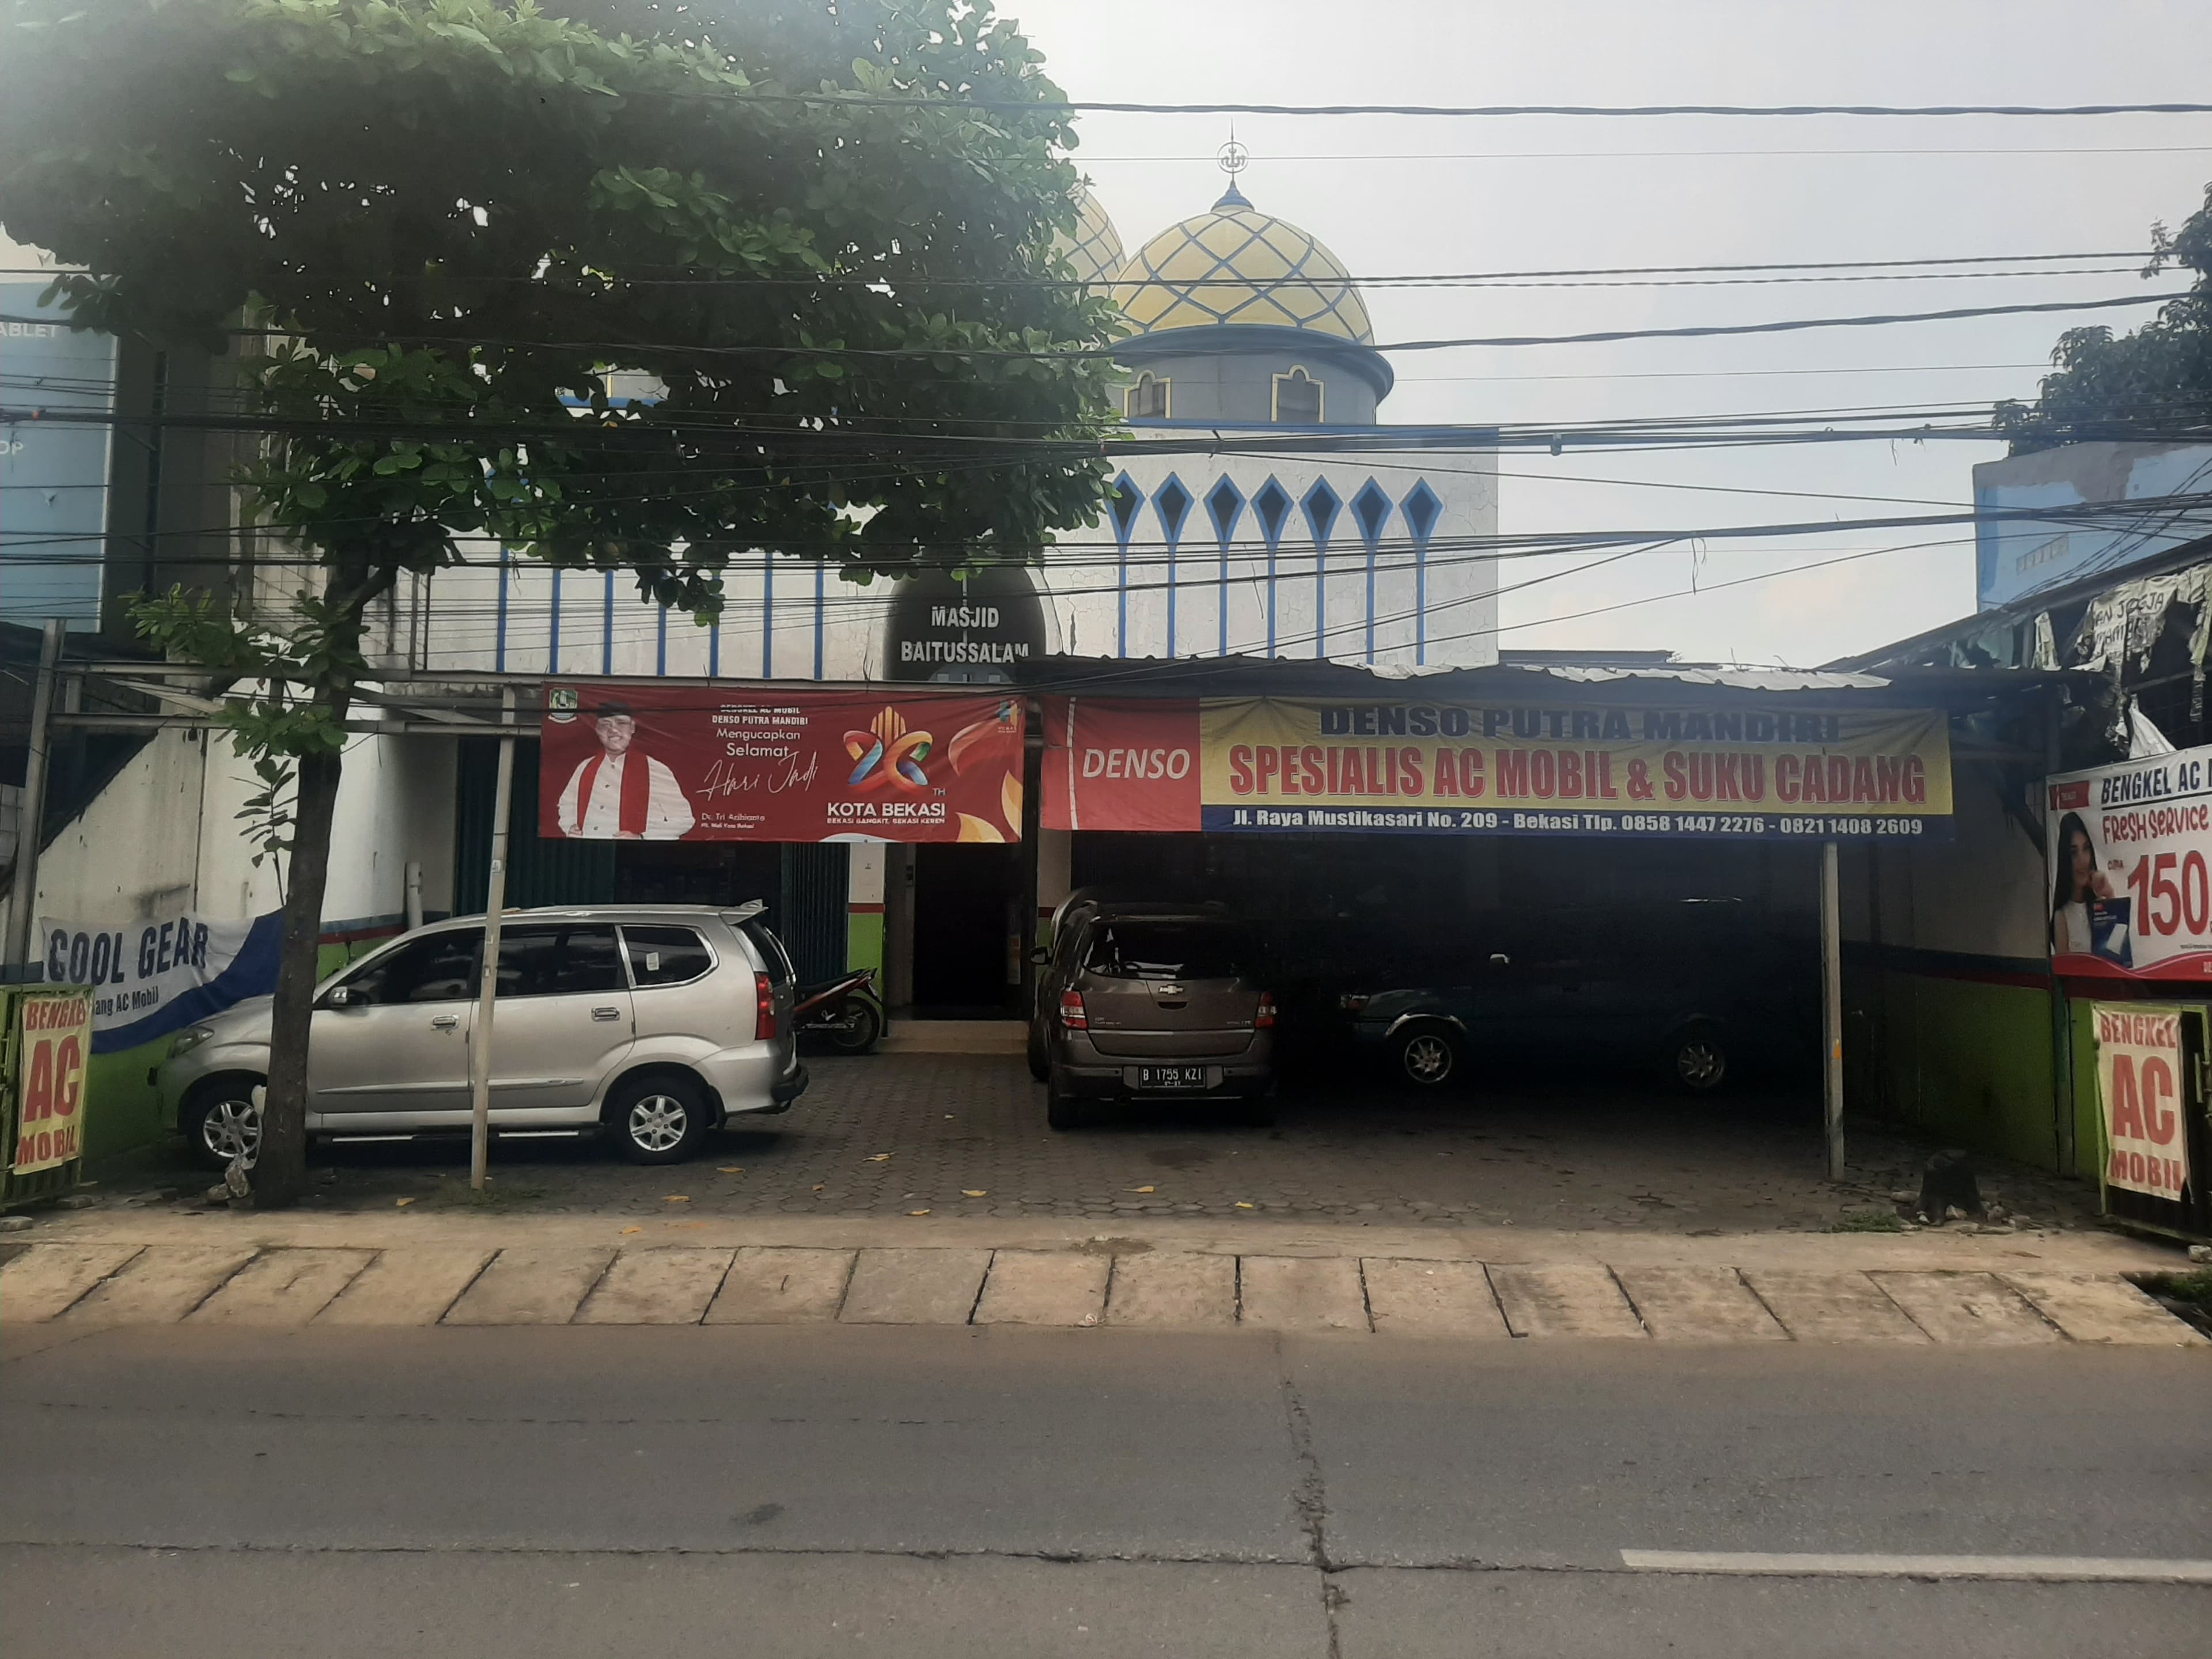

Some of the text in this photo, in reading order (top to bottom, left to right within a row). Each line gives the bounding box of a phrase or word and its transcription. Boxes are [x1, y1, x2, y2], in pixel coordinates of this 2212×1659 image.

[931, 606, 999, 627] MASJID
[901, 641, 1029, 663] BAITUSSALAM
[712, 715, 808, 725] DENSO PUTRA MANDIRI
[716, 728, 801, 741] Mengucapkan
[1319, 706, 1842, 744] DENSO PUTRA MANDIRI
[726, 743, 789, 757] Selamat
[1082, 748, 1190, 779] DENSO
[696, 750, 818, 801] Hari Jadi
[1228, 744, 1927, 804] SPESIALIS AC MOBIL & SUKU CADANG
[2101, 767, 2172, 804] BENGKEL
[2177, 760, 2200, 792] AC
[828, 802, 945, 817] KOTA BEKASI
[1233, 810, 1252, 825] Jl.
[1256, 810, 1304, 827] Raya
[1308, 810, 1423, 827] Mustikasari
[1427, 812, 1457, 828] No.
[1460, 812, 1498, 828] 209
[1513, 813, 1579, 830] Bekasi
[1583, 814, 1618, 831] Tlp.
[1621, 815, 1671, 831] 0858
[1675, 816, 1716, 832] 1447
[1720, 817, 1764, 833] 2276
[1780, 817, 1824, 834] 0821
[1828, 819, 1873, 834] 1408
[1876, 819, 1923, 835] 2609
[2127, 850, 2210, 937] 150
[48, 916, 209, 986] COOL GEAR
[94, 986, 159, 1016] ang AC Mobil
[2101, 1013, 2176, 1048] BENGKEL
[24, 1035, 81, 1123] AC
[1143, 1069, 1149, 1081] B
[1185, 1068, 1202, 1080] KZI
[2112, 1054, 2175, 1146] AC
[17, 1126, 76, 1165] MOBIL
[2111, 1149, 2181, 1191] MOBIL
